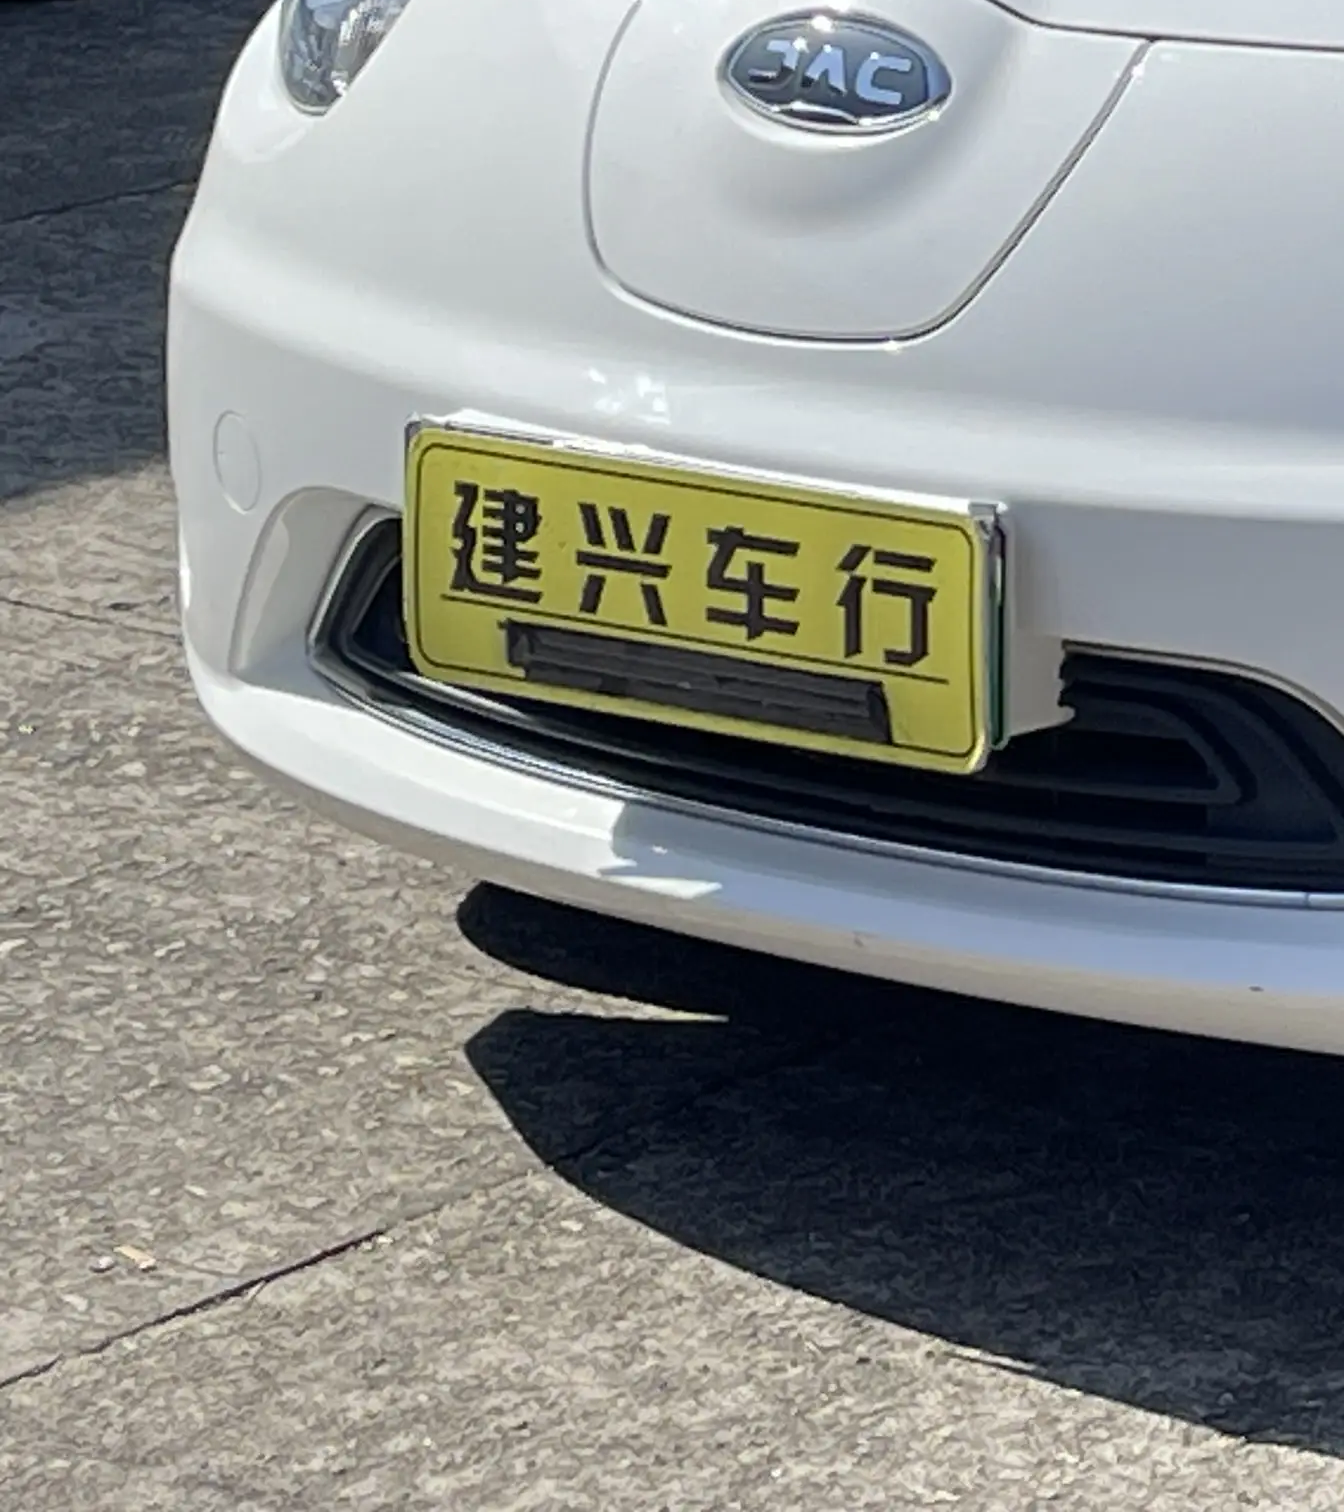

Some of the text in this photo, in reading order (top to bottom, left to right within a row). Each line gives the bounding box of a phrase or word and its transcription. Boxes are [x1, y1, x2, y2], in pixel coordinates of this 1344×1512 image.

[747, 37, 912, 106] JAC
[448, 481, 938, 667] 建兴车行
